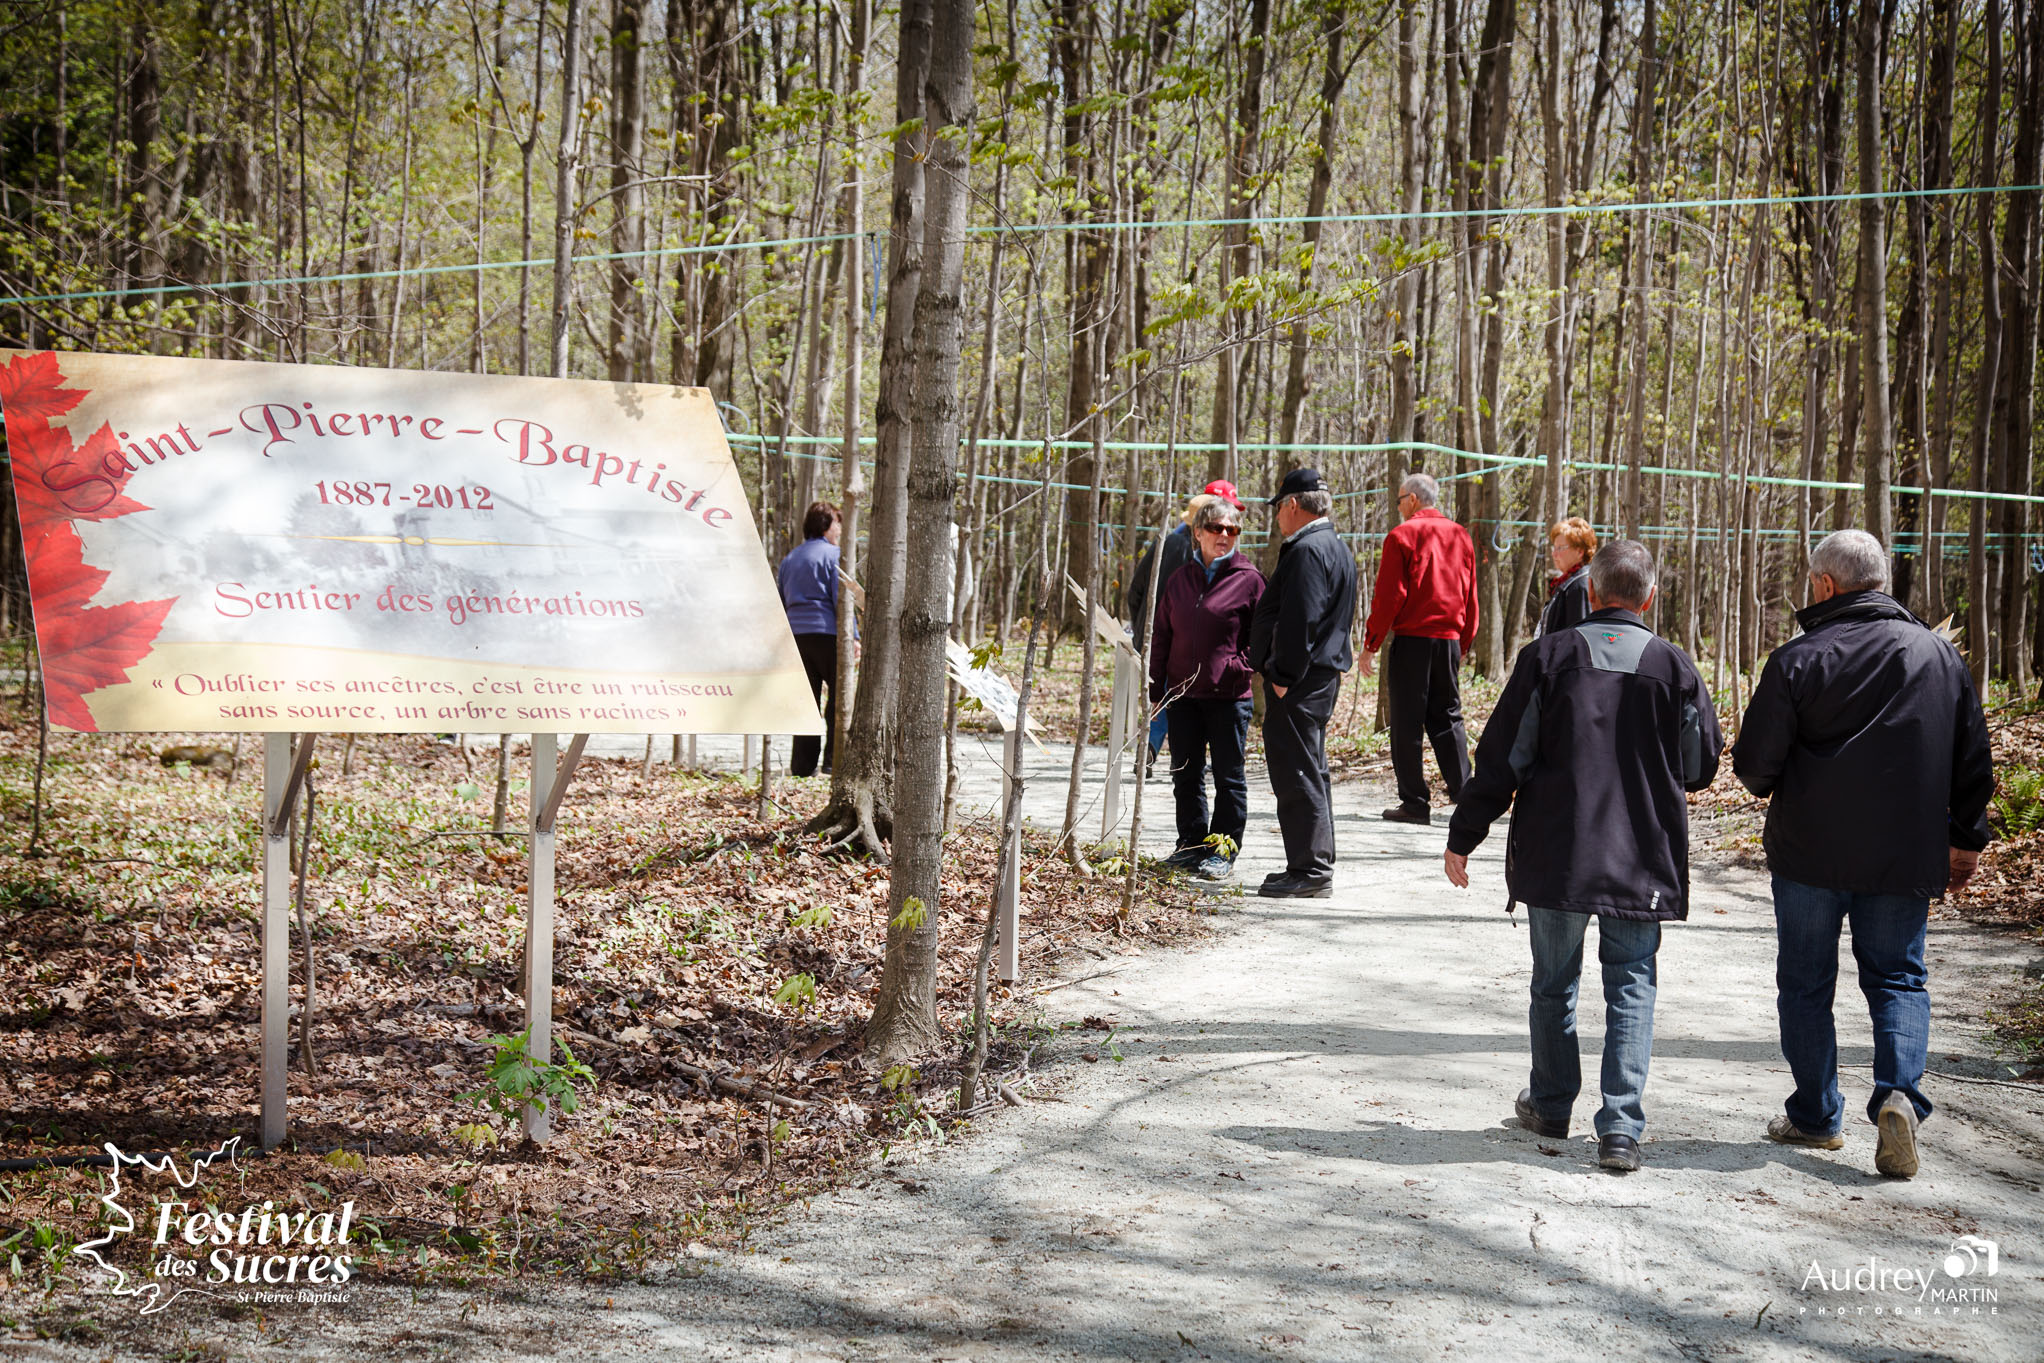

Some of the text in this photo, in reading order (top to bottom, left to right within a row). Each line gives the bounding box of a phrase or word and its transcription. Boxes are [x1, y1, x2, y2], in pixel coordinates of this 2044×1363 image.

[315, 480, 494, 511] 1887-2012
[214, 582, 645, 626] Sentier des générations
[174, 673, 285, 696] Oublier
[296, 679, 335, 692] ses
[345, 676, 463, 696] ancêtres,
[533, 677, 583, 695] être
[592, 682, 623, 696] un
[631, 680, 734, 697] ruisseau
[219, 704, 278, 719] sans
[287, 704, 386, 720] source,
[396, 706, 427, 719] un
[438, 701, 507, 720] arbre
[516, 706, 571, 720] sans
[579, 703, 670, 720] racines
